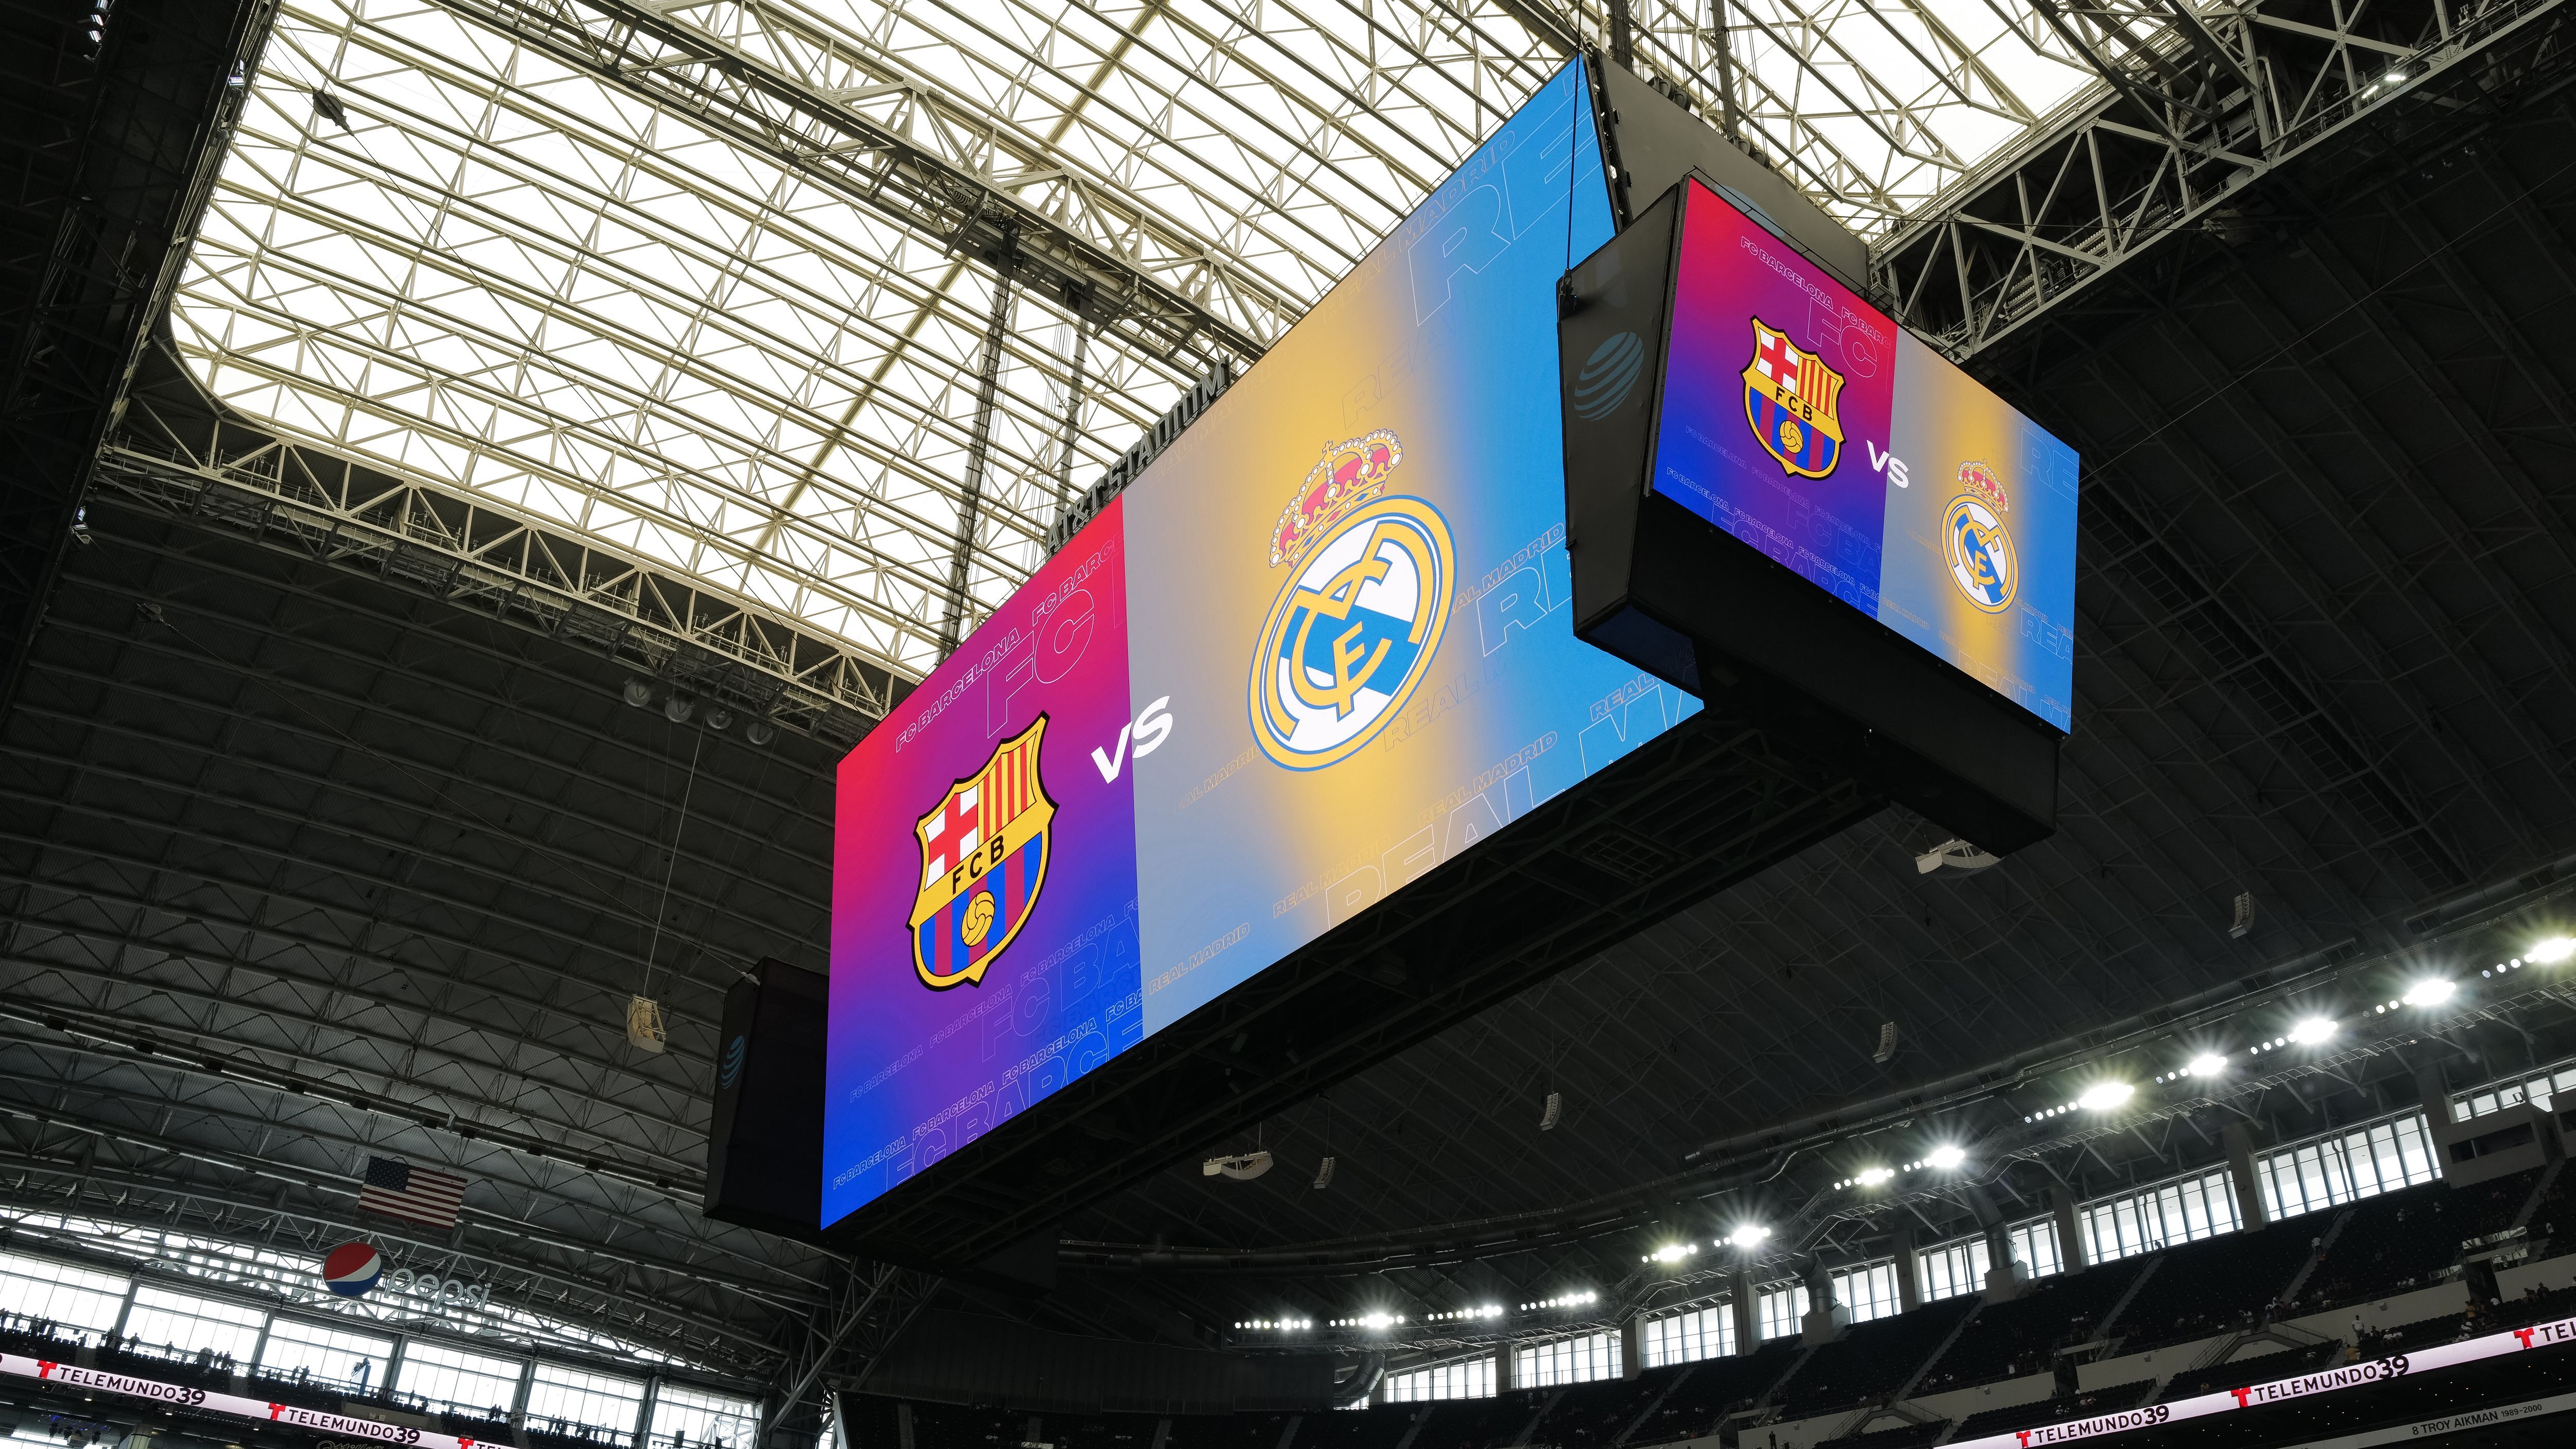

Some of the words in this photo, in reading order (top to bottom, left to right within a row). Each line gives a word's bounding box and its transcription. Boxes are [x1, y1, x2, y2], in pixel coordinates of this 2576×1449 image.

[1396, 130, 1515, 252] MADRID
[1741, 236, 1758, 256] FC
[1759, 249, 1833, 309] BARCELONA
[1807, 297, 1877, 377] FC
[1842, 306, 1857, 325] FC
[1775, 386, 1813, 421] FCB
[1046, 478, 1105, 563] AT&T
[1108, 355, 1231, 499] STADIUM
[1697, 433, 1746, 469] BARCELONA
[1763, 475, 1810, 509] BARCELONA
[1826, 512, 1870, 544] BARCELONA
[1866, 439, 1909, 488] VS
[1482, 523, 1564, 591] MADRID
[1667, 467, 1678, 479] FC
[1679, 474, 1729, 511] BARCELONA
[1734, 508, 1746, 520] FC
[1746, 514, 1793, 549] BARCELONA
[1810, 553, 1856, 585] BARCELONA
[1033, 593, 1056, 627] FC
[896, 723, 917, 753] FC
[918, 628, 1020, 732] BARCELONA
[987, 589, 1094, 738] FC
[1091, 696, 1173, 784] VS
[952, 835, 1004, 895] FCB
[1149, 964, 1189, 995] REAL
[1189, 923, 1250, 969] MADRID
[1273, 881, 1318, 919] REAL
[1319, 835, 1392, 889] MADRID
[1418, 786, 1471, 827] REAL
[1472, 731, 1558, 792] MADRID
[1590, 673, 1655, 722] REAL
[850, 1090, 863, 1103] FC
[864, 1045, 923, 1094] BARCELONA
[930, 1030, 944, 1048] FC
[945, 984, 1013, 1038] BARCELONA
[1021, 968, 1037, 987] FC
[1038, 915, 1115, 975] BARCELONA
[982, 978, 1050, 1063] FC
[833, 1175, 846, 1190] FC
[847, 1136, 906, 1182] BARCELONA
[913, 1123, 926, 1141] FC
[927, 1080, 995, 1132] BARCELONA
[1003, 1065, 1019, 1085] FC
[1020, 1017, 1097, 1075] BARCELONA
[1106, 1001, 1124, 1022] FC
[384, 1268, 492, 1310] pepsi
[2412, 1426, 2419, 1435] 8
[2421, 1420, 2450, 1434] TROY
[2454, 1411, 2499, 1427] AIKMAN
